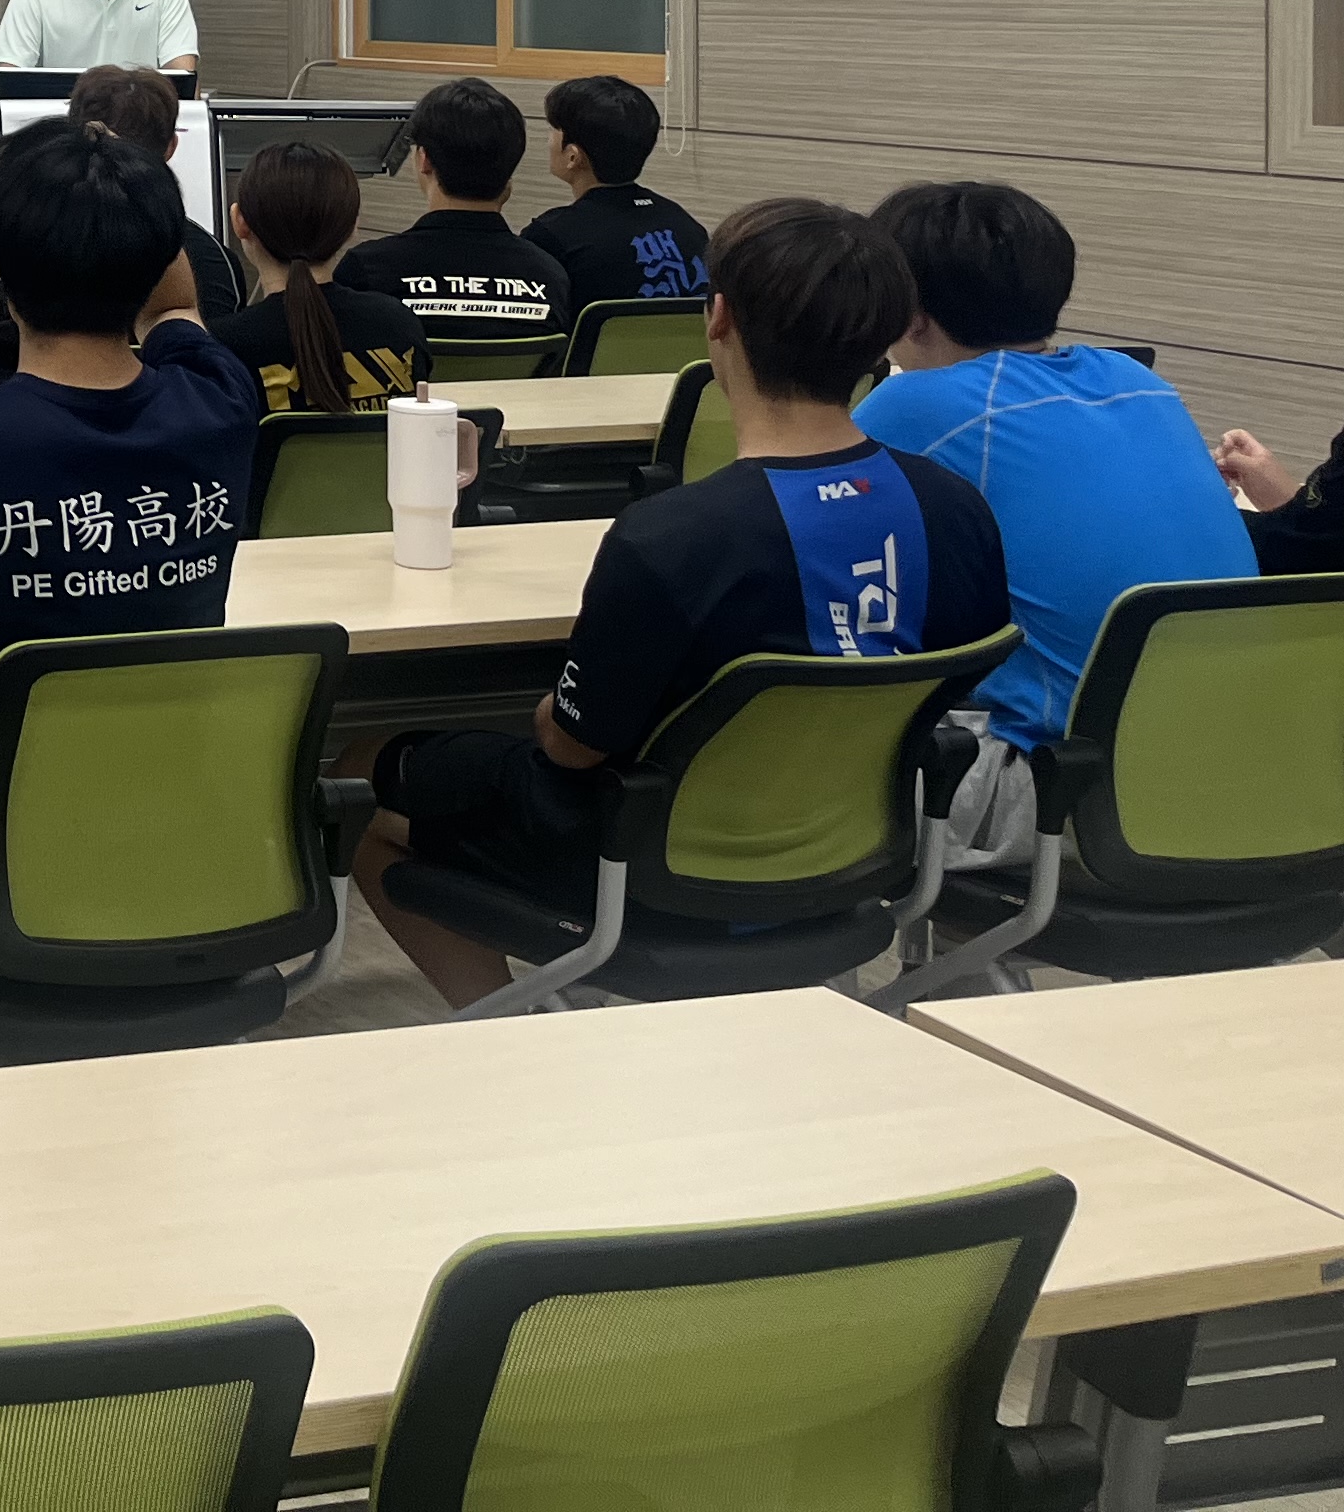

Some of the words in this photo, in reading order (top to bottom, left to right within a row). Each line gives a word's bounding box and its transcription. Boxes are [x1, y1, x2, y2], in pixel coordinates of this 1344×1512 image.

[401, 276, 437, 293] TO
[443, 276, 490, 294] THE
[493, 277, 547, 300] MAX
[461, 304, 498, 313] YOUR
[501, 305, 544, 316] LIMITS
[12, 573, 54, 598] PE
[64, 565, 148, 597] Gifted
[158, 554, 217, 587] Class
